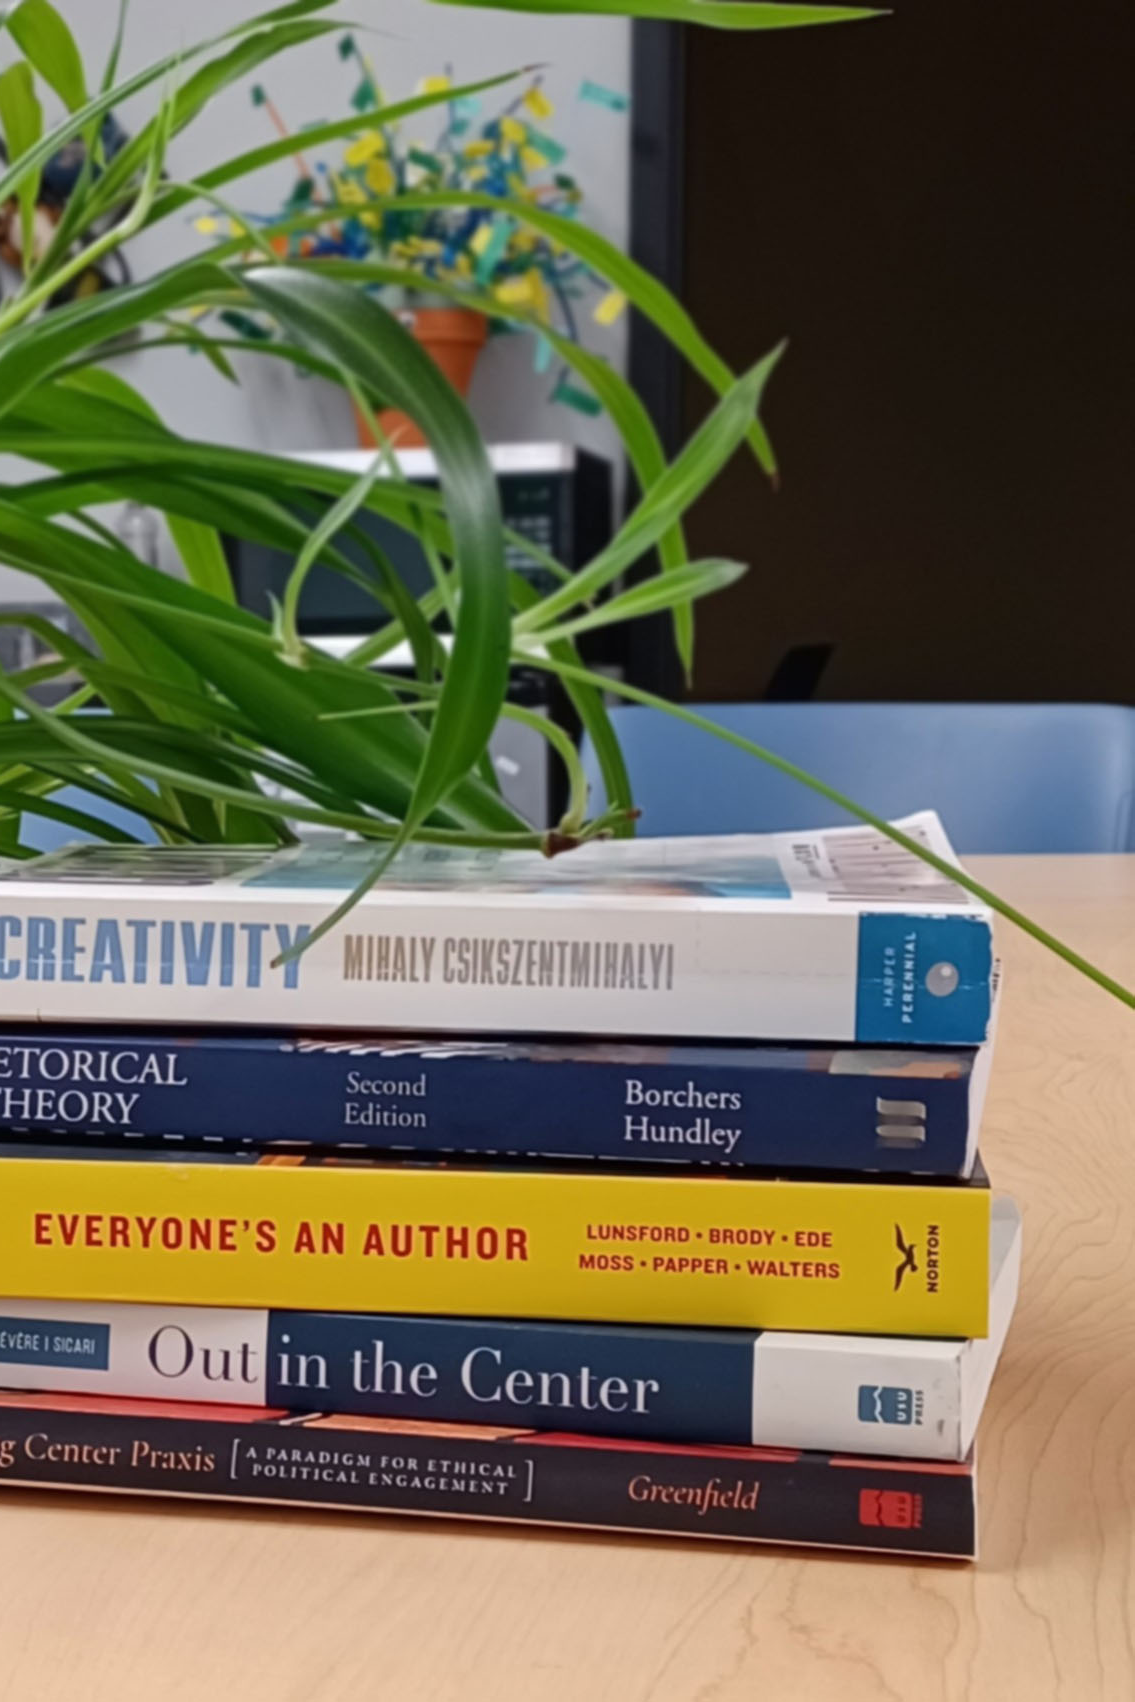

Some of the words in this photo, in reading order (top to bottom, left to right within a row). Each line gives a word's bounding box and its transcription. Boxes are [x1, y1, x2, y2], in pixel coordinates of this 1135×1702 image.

[343, 934, 436, 983] MIHALY
[443, 937, 674, 990] CSIKSZENTMIHALYI
[883, 946, 896, 1007] HARPER
[902, 931, 916, 1023] PERENNIAL
[345, 1072, 426, 1096] Second
[625, 1079, 741, 1110] Borchers
[343, 1102, 427, 1127] Edition
[624, 1115, 741, 1153] Hundley
[34, 1213, 277, 1253] EVERYONE'S
[294, 1221, 344, 1255] AN
[363, 1223, 528, 1261] AUTHOR
[586, 1224, 690, 1242] LUNSFORD
[709, 1228, 775, 1246] BRODY
[794, 1231, 833, 1247] EDE
[579, 1254, 634, 1271] MOSS
[652, 1256, 728, 1275] PAPPER
[747, 1260, 840, 1279] WALTERS
[927, 1224, 939, 1293] NORTON
[53, 1338, 96, 1355] SICARI
[148, 1325, 259, 1384] Out
[276, 1334, 330, 1390] in
[350, 1340, 438, 1397] the
[460, 1347, 659, 1414] Center
[24, 1433, 121, 1466] Center
[130, 1440, 216, 1473] Praxis
[266, 1447, 371, 1468] PARADIGM
[380, 1456, 418, 1470] FOR
[427, 1460, 517, 1478] ETHICAL
[252, 1463, 360, 1484] POLITICAL
[369, 1472, 510, 1495] ENGAGEMENT
[628, 1475, 760, 1516] Greenfield
